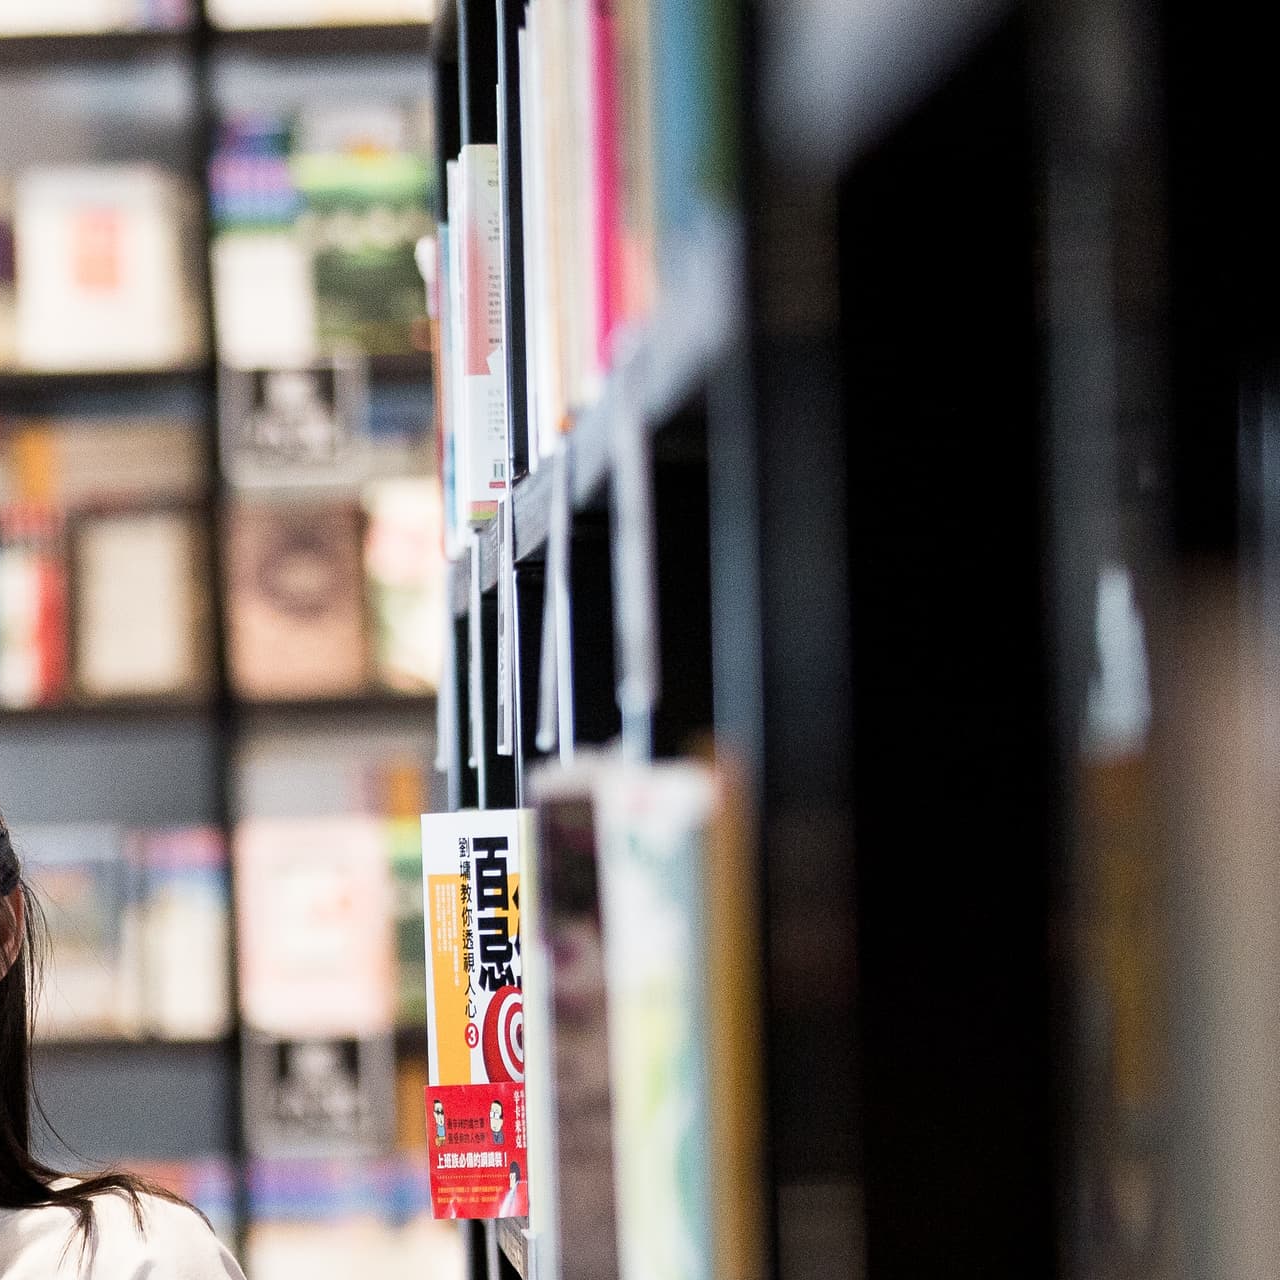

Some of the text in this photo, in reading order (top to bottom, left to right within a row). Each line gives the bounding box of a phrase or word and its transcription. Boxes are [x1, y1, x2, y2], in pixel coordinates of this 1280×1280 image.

[458, 837, 478, 1019] 劉墉教你透視人心
